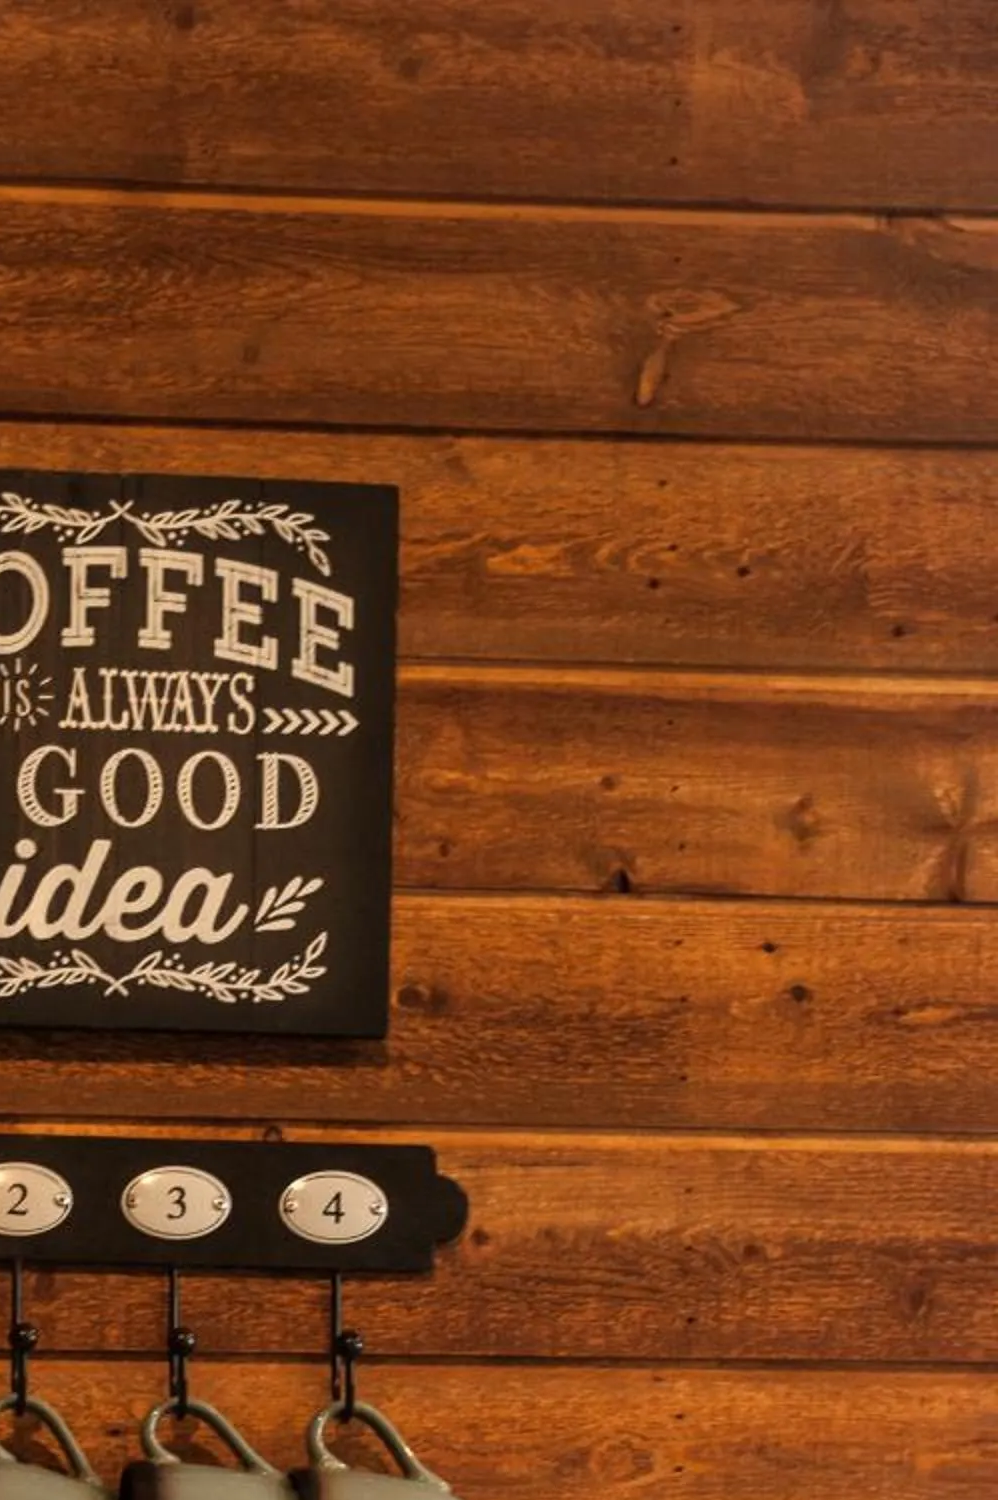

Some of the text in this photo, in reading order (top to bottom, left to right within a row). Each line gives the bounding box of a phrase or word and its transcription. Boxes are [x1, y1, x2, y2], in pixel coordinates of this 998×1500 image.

[3, 667, 255, 735] IS ALWAYS
[16, 744, 320, 830] GOOD
[7, 1183, 30, 1216] 2
[167, 1187, 188, 1220] 3
[323, 1191, 346, 1224] 4
